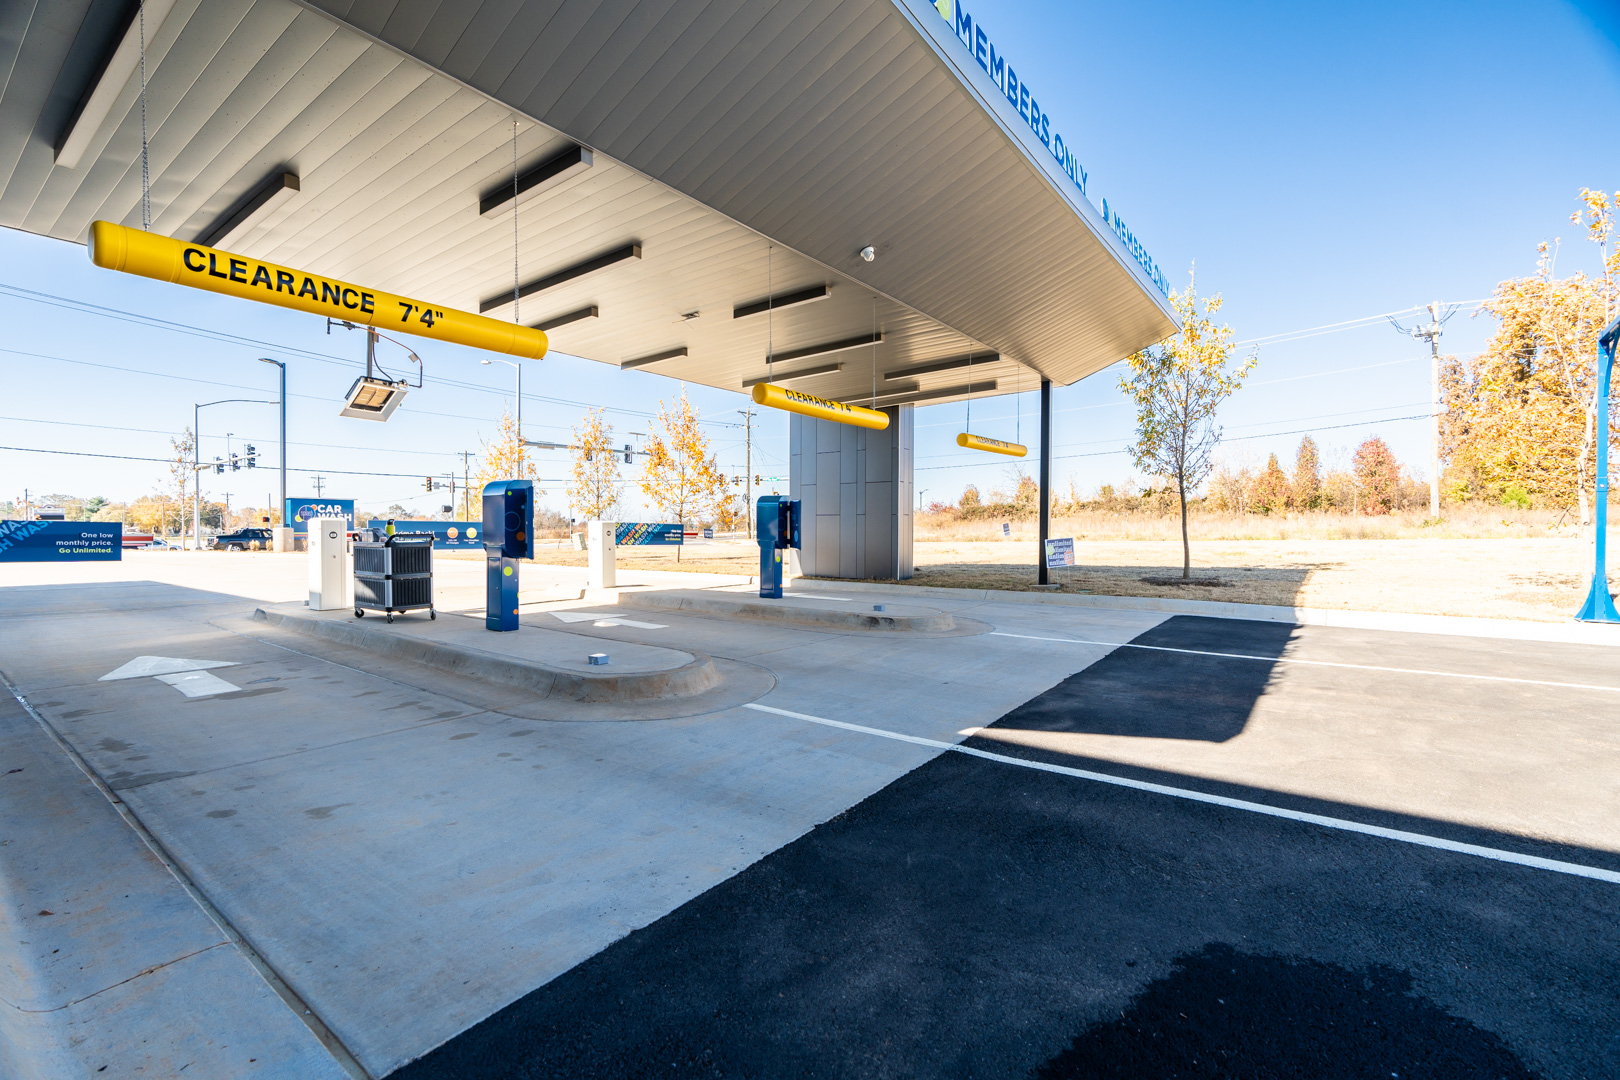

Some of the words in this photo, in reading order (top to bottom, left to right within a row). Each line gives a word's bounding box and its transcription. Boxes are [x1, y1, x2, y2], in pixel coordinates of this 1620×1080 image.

[953, 0, 1050, 148] MEMBERS
[1053, 133, 1088, 197] ONLY
[1113, 210, 1152, 278] MEMBERS
[1154, 264, 1169, 299] ONLY
[183, 248, 375, 315] CLEARANCE
[785, 389, 836, 410] CLEARANCE
[317, 504, 342, 513] CAR
[11, 521, 53, 541] WAS
